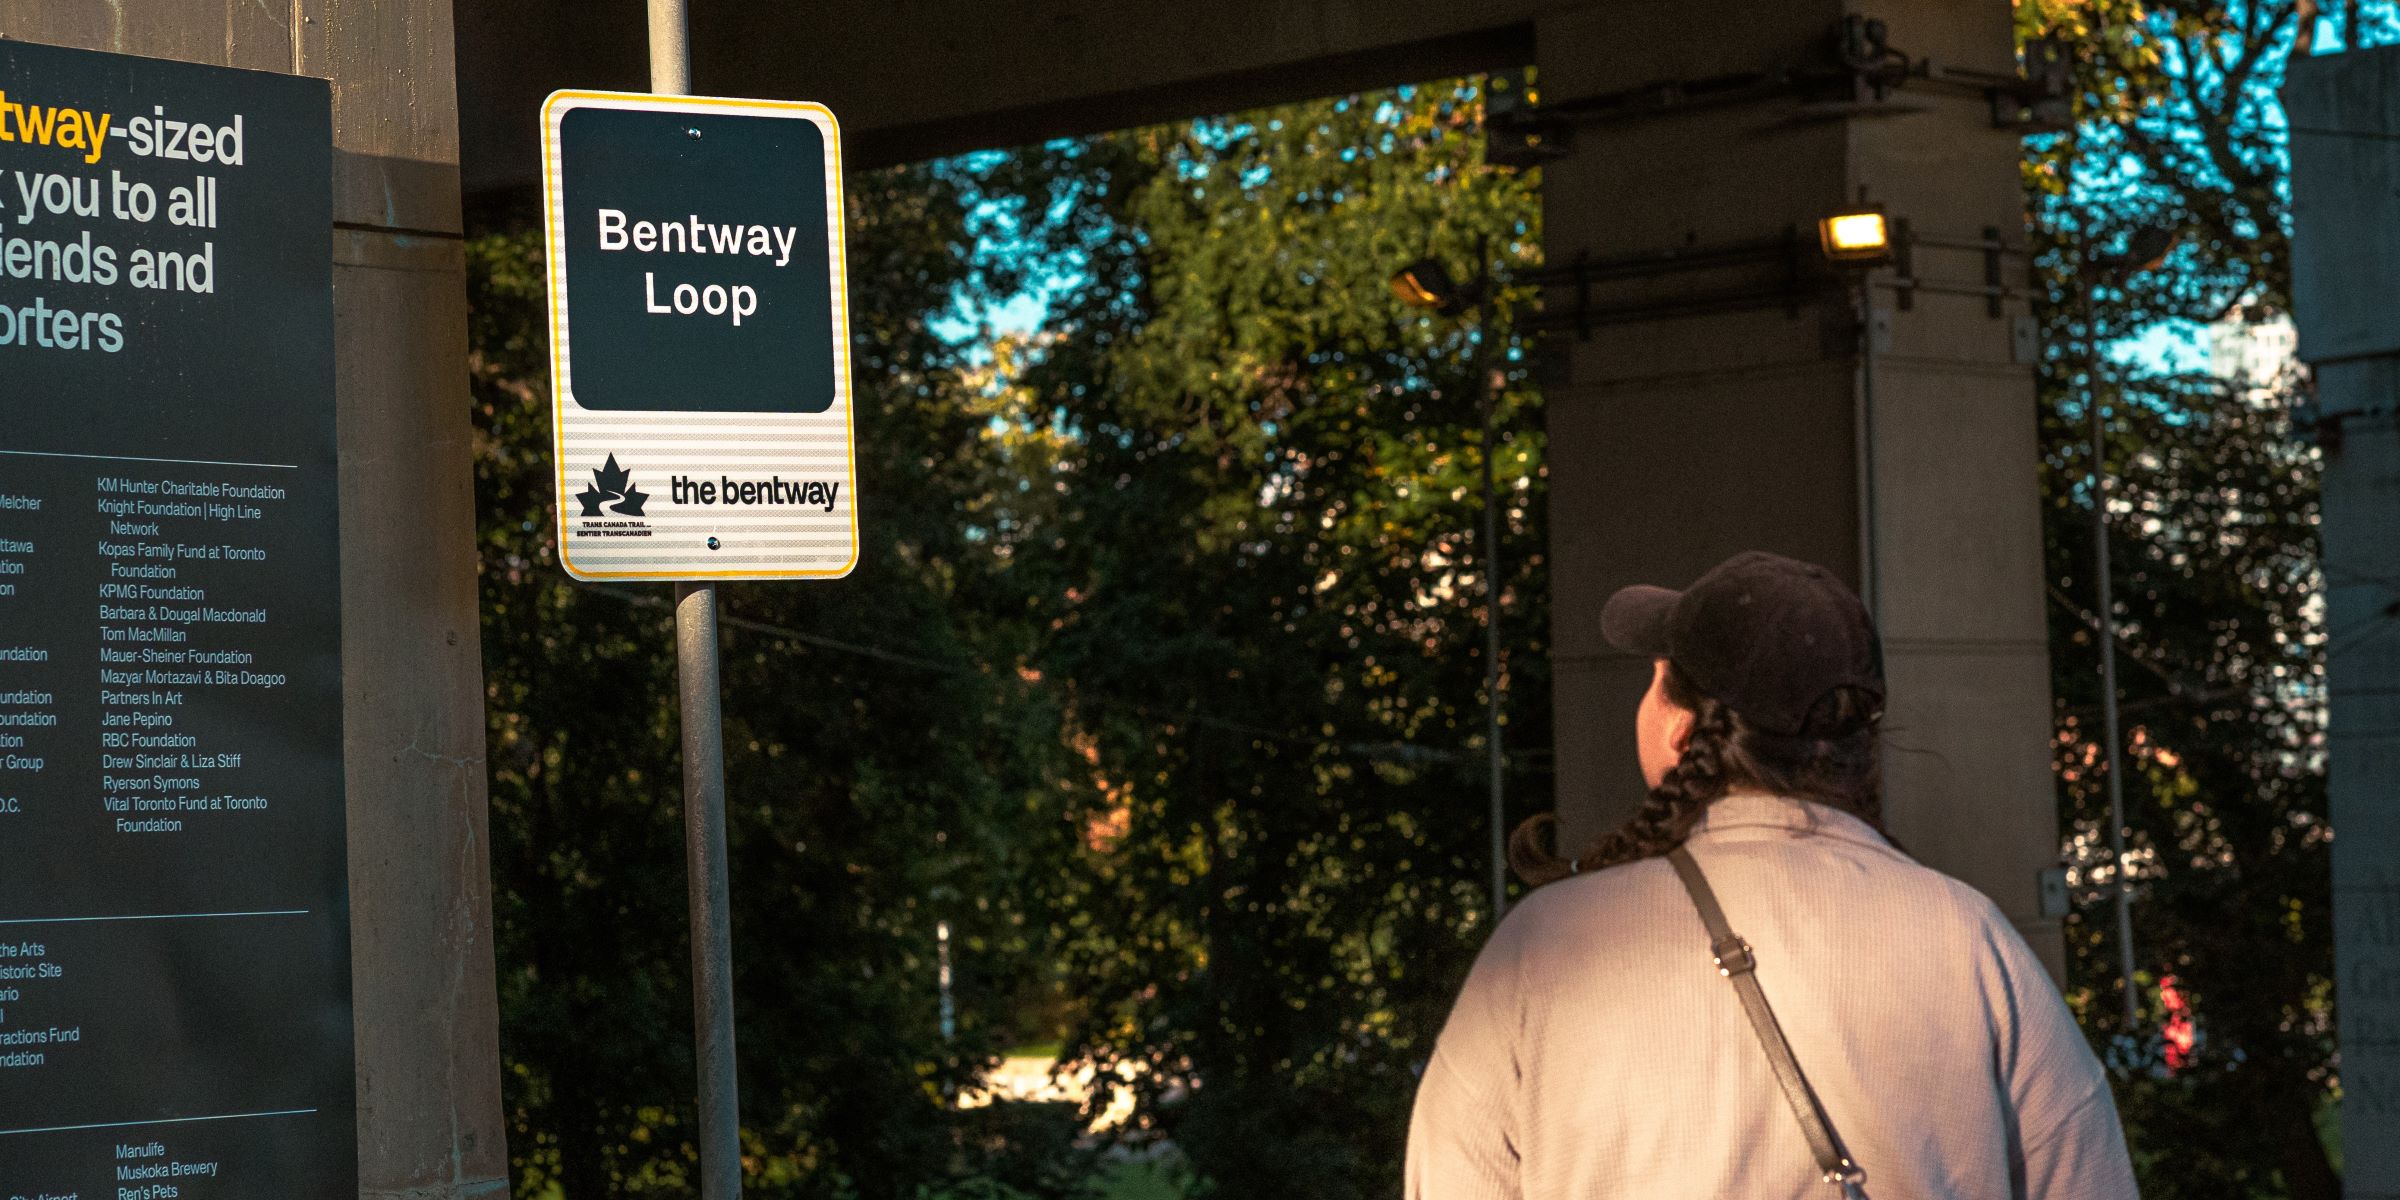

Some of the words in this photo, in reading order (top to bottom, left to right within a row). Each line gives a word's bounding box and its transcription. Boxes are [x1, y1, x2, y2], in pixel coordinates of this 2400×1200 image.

[15, 171, 99, 224] you
[112, 170, 156, 222] to
[168, 176, 216, 228] all
[599, 208, 796, 266] Bentway
[129, 242, 214, 293] and
[645, 272, 757, 326] Loop
[98, 478, 117, 492] KM
[120, 479, 159, 494] Hunter
[161, 480, 219, 496] Charitable
[222, 483, 285, 499] Foundation
[672, 476, 716, 504] the
[721, 476, 839, 512] bentway
[98, 499, 135, 517] Knight
[137, 501, 201, 516] Foundation
[209, 503, 235, 520] High
[237, 504, 261, 518] Line
[111, 521, 159, 536] Network
[99, 541, 135, 559] Kopas
[138, 543, 175, 560] Family
[177, 544, 205, 558] Fund
[208, 546, 220, 560] at
[222, 546, 265, 560] Toronto
[111, 563, 176, 579] Foundation
[100, 584, 137, 598] KPMG
[140, 585, 204, 600] Foundation
[100, 605, 146, 620] Barbara
[149, 607, 157, 620] &
[160, 607, 200, 624] Dougal
[203, 608, 266, 623] Macdonald
[101, 627, 126, 641] Tom
[128, 627, 186, 642] MacMillan
[101, 648, 186, 663] Mauer-Sheiner
[188, 649, 252, 664] Foundation
[101, 670, 143, 687] Mazyar
[146, 670, 201, 685] Mortazavi
[204, 671, 213, 684] &
[216, 671, 238, 685] Bita
[241, 672, 285, 688] Doagoo
[102, 691, 149, 705] Partners
[152, 691, 162, 705] In
[165, 691, 182, 705] Art
[102, 713, 130, 726] Jane
[133, 712, 172, 729] Pepino
[102, 733, 129, 747] RBC
[132, 733, 195, 747] Foundation
[6, 756, 43, 773] Group
[103, 755, 132, 769] Drew
[136, 754, 178, 769] Sinclair
[180, 755, 189, 768] &
[192, 754, 215, 768] Liza
[218, 753, 241, 768] Stiff
[103, 776, 150, 793] Ryerson
[153, 776, 200, 792] Symons
[104, 796, 129, 811] Vital
[132, 797, 176, 811] Toronto
[179, 796, 207, 810] Fund
[210, 798, 222, 810] at
[224, 796, 267, 810] Toronto
[117, 818, 182, 832] Foundation
[20, 942, 45, 956] Arts
[39, 963, 62, 978] Site
[49, 1027, 79, 1042] Fund
[116, 1142, 164, 1159] Manulife
[117, 1164, 169, 1180] Muskoka
[171, 1161, 217, 1177] Brewery
[118, 1187, 150, 1200] Ren's
[153, 1184, 178, 1199] Pets
